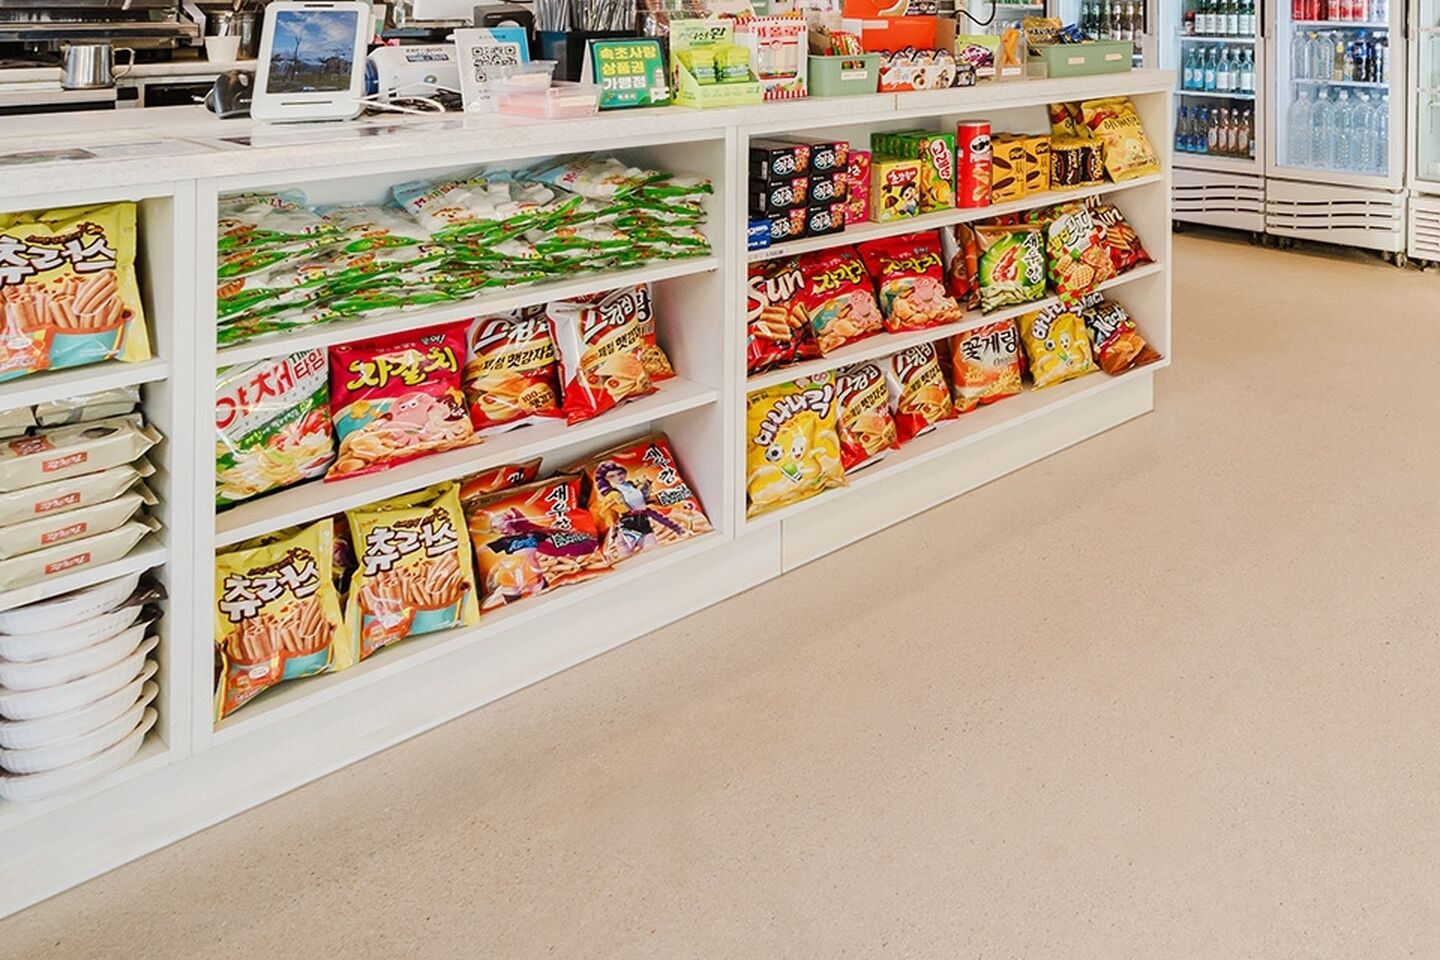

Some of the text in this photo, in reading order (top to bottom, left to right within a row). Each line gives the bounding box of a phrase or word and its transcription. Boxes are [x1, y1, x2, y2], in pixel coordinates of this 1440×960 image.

[600, 46, 657, 61] 속초사랑
[601, 61, 644, 77] 상품권
[602, 76, 647, 91] 가맹점
[879, 252, 943, 277] 자갈치
[962, 327, 1018, 361] 꽃게랑
[214, 360, 294, 430] 야채
[293, 348, 326, 385] 타임
[347, 345, 459, 390] 자갈치
[752, 384, 834, 447] 바나나킥
[544, 483, 573, 530] 새우깡
[362, 520, 459, 578] 츄러스
[218, 559, 322, 624] 츄러스
